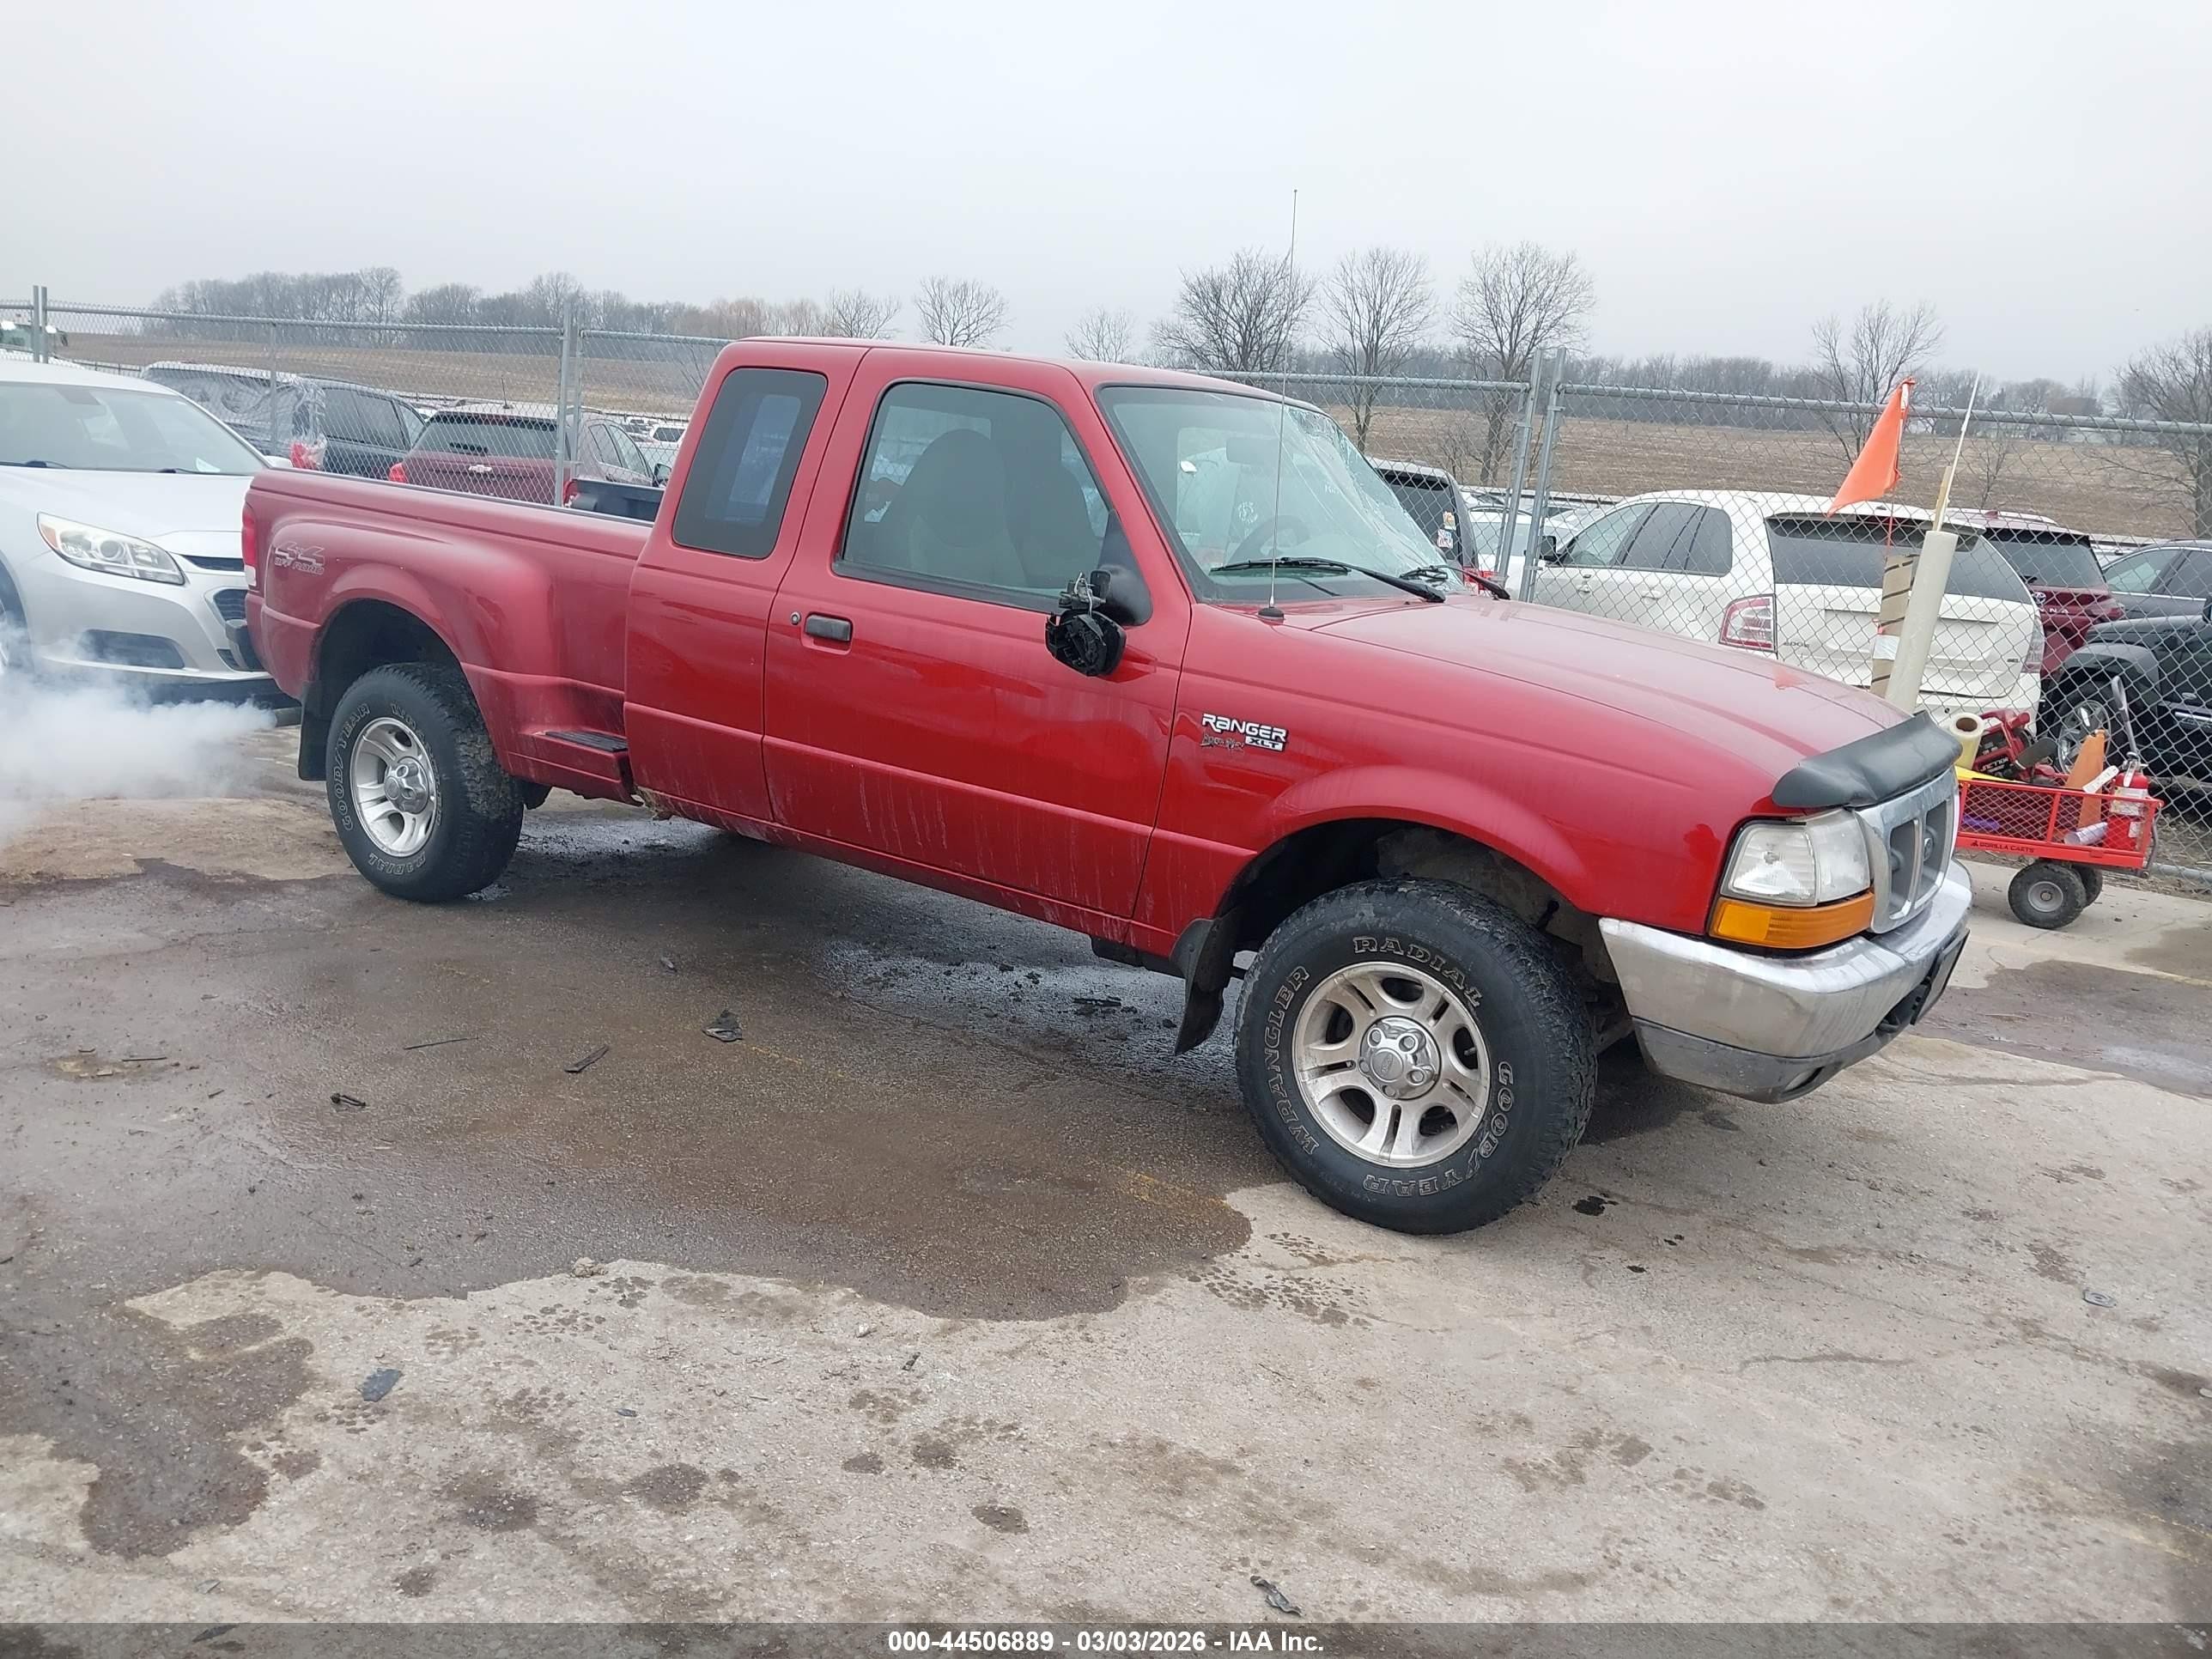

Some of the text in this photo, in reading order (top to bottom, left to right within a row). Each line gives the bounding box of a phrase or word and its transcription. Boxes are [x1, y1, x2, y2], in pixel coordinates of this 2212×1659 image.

[1249, 737, 1279, 750] XLT
[1353, 936, 1483, 1007] RADIAL
[1264, 965, 1321, 1157] WRANGLER
